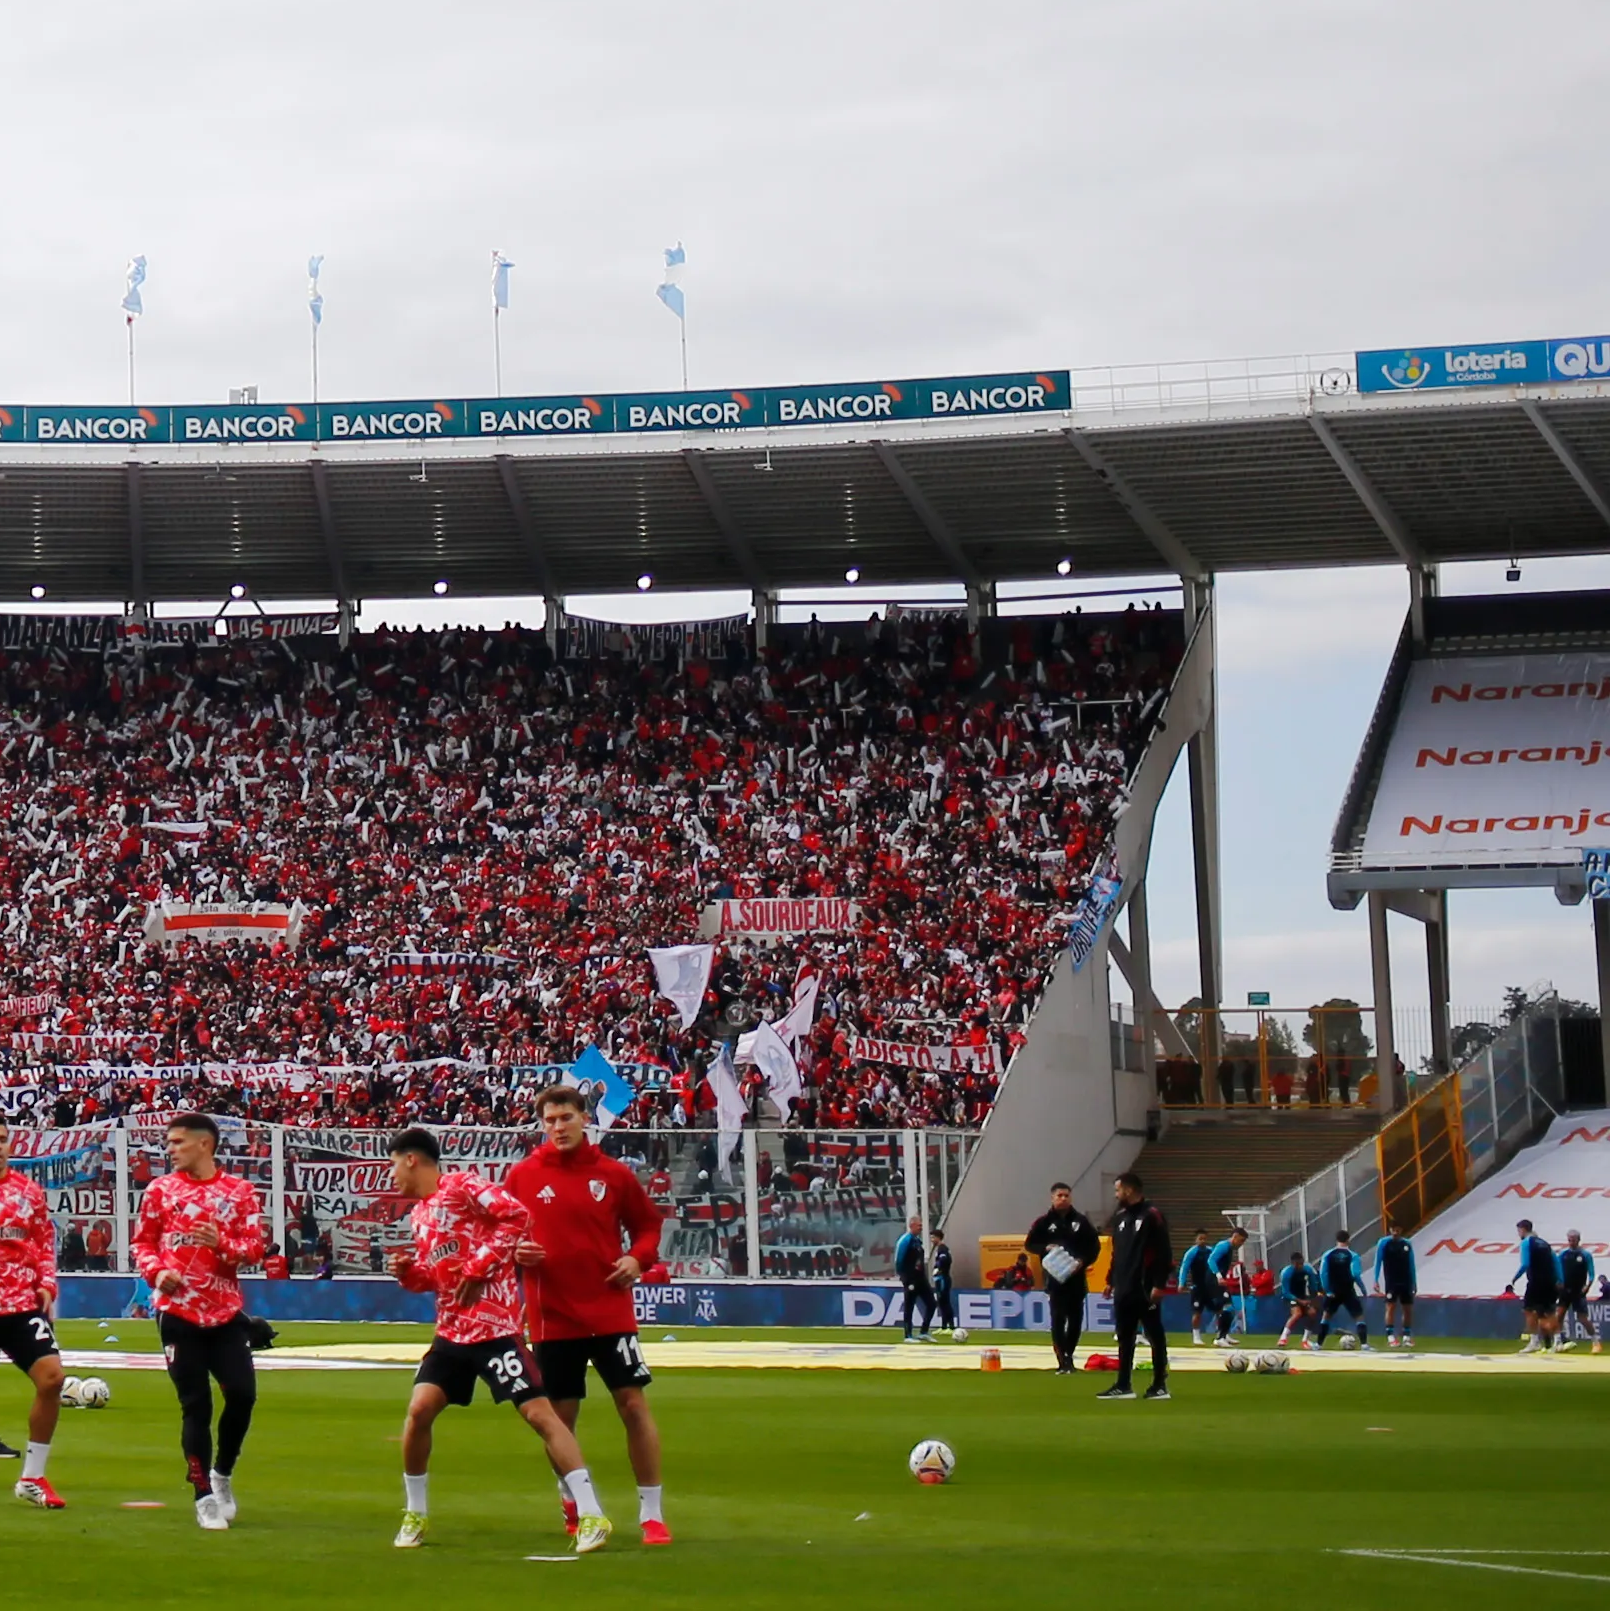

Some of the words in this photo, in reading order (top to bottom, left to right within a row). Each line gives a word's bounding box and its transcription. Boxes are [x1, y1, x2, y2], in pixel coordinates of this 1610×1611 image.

[1456, 372, 1497, 382] Córdoba
[778, 394, 892, 422] BANCOR
[931, 384, 1045, 413] BANCOR
[37, 415, 147, 440] BANCOR
[185, 412, 295, 439] BANCOR
[331, 411, 442, 437] BANCOR
[479, 407, 591, 432] BANCOR
[627, 402, 741, 428] BANCOR
[1415, 740, 1610, 768] Naranj
[720, 899, 850, 933] A.SOURDEAUX
[855, 1038, 933, 1068] ADICTO
[617, 1335, 644, 1366] 11
[487, 1350, 524, 1385] 26
